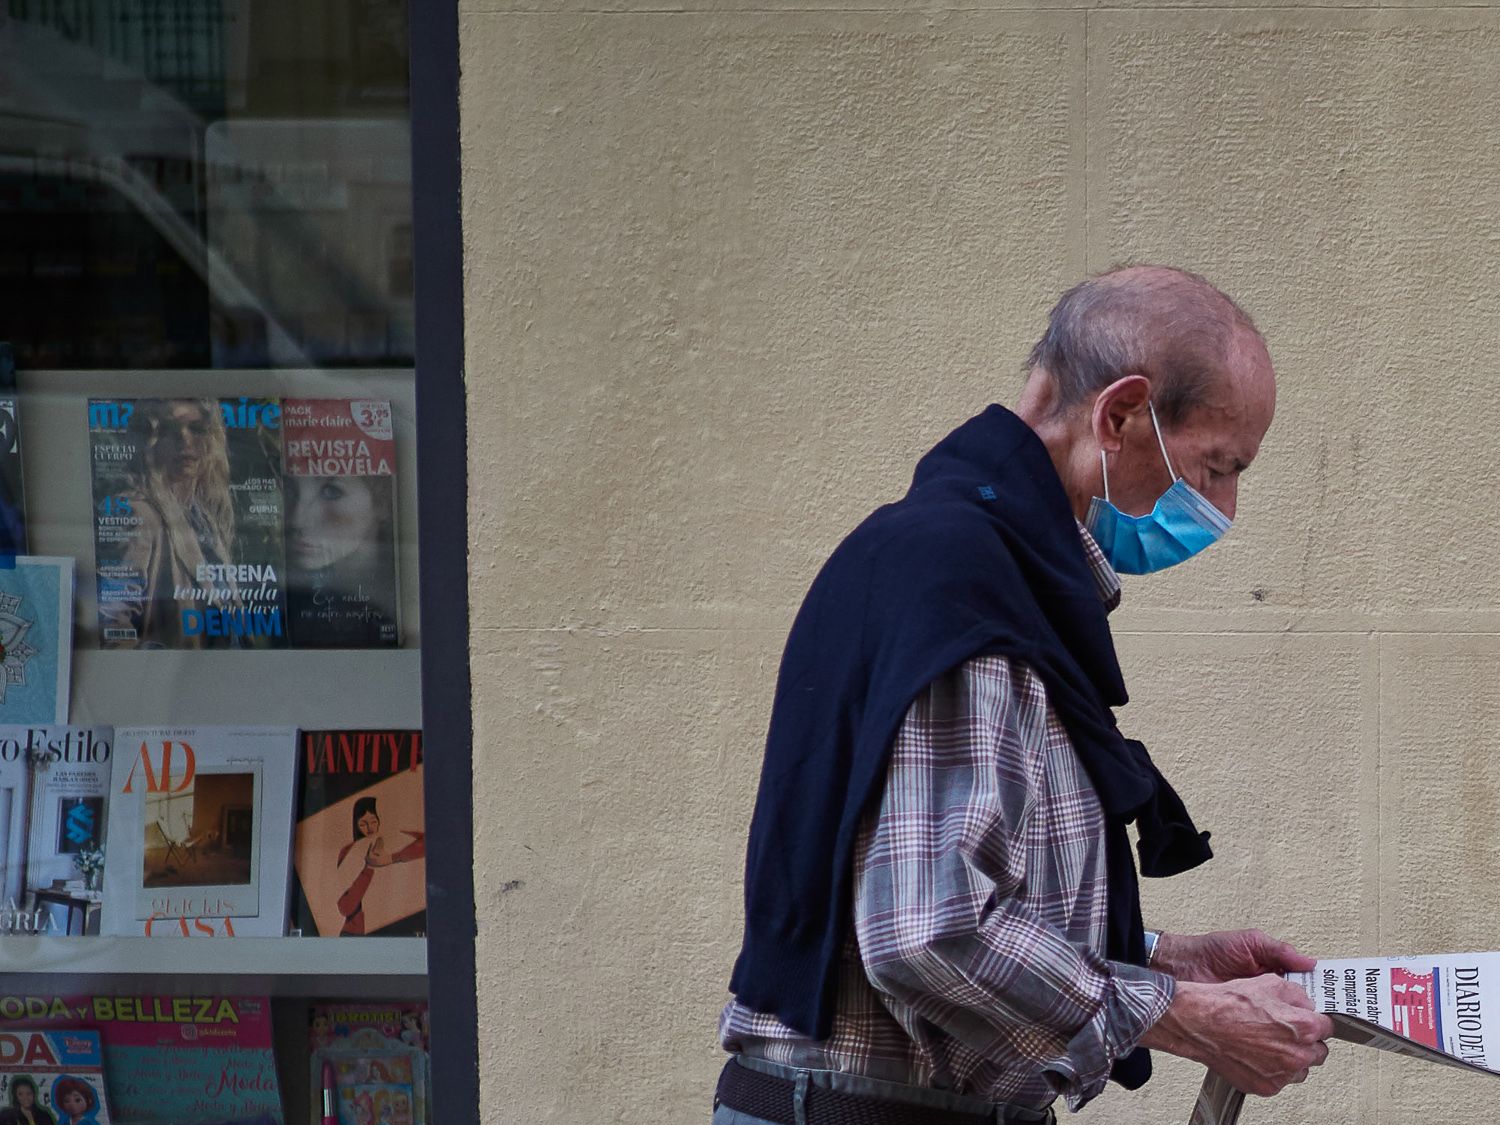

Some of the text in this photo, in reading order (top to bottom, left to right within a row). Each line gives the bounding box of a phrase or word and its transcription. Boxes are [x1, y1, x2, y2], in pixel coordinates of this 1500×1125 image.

[284, 405, 312, 416] PACK
[320, 415, 353, 428] claire
[287, 440, 371, 457] REVISTA
[307, 458, 392, 477] NOVELA
[97, 494, 133, 517] 48
[98, 516, 144, 526] VESTIDOS
[195, 564, 277, 583] ESTRENA
[172, 582, 278, 606] temporada
[181, 607, 283, 638] DENIM
[25, 728, 111, 763] Estilo
[306, 733, 405, 774] VANITY
[121, 740, 197, 794] AD
[1323, 968, 1340, 987] sólo
[1342, 968, 1361, 1007] campaña
[1365, 968, 1381, 1005] Navarra
[1321, 986, 1336, 1000] por
[1454, 966, 1482, 1031] DIARIO
[0, 995, 73, 1019] ODA
[93, 997, 240, 1025] BELLEZA
[0, 1033, 57, 1066] DA
[1458, 1033, 1485, 1053] DE
[205, 1065, 273, 1099] Moda
